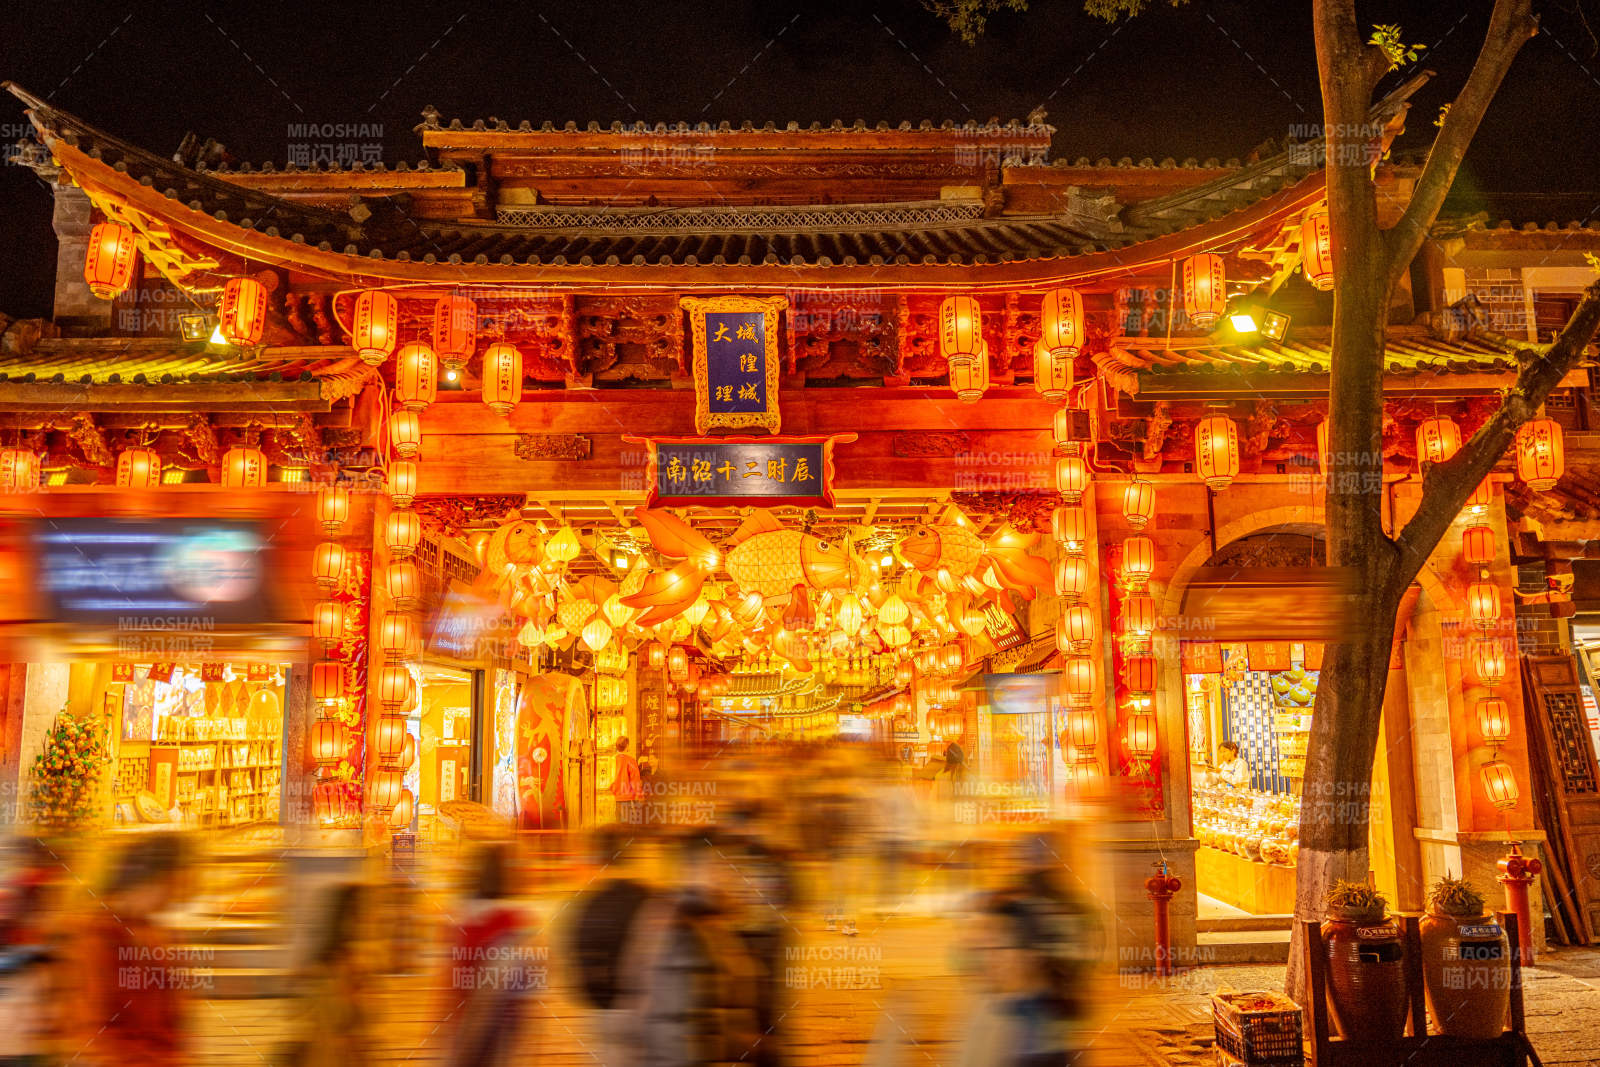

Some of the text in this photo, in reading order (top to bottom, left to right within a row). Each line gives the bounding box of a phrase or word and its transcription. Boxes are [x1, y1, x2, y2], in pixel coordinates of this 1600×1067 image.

[711, 322, 734, 402] 大理
[735, 322, 760, 403] 城隍城
[666, 456, 815, 485] 南诏十二时辰
